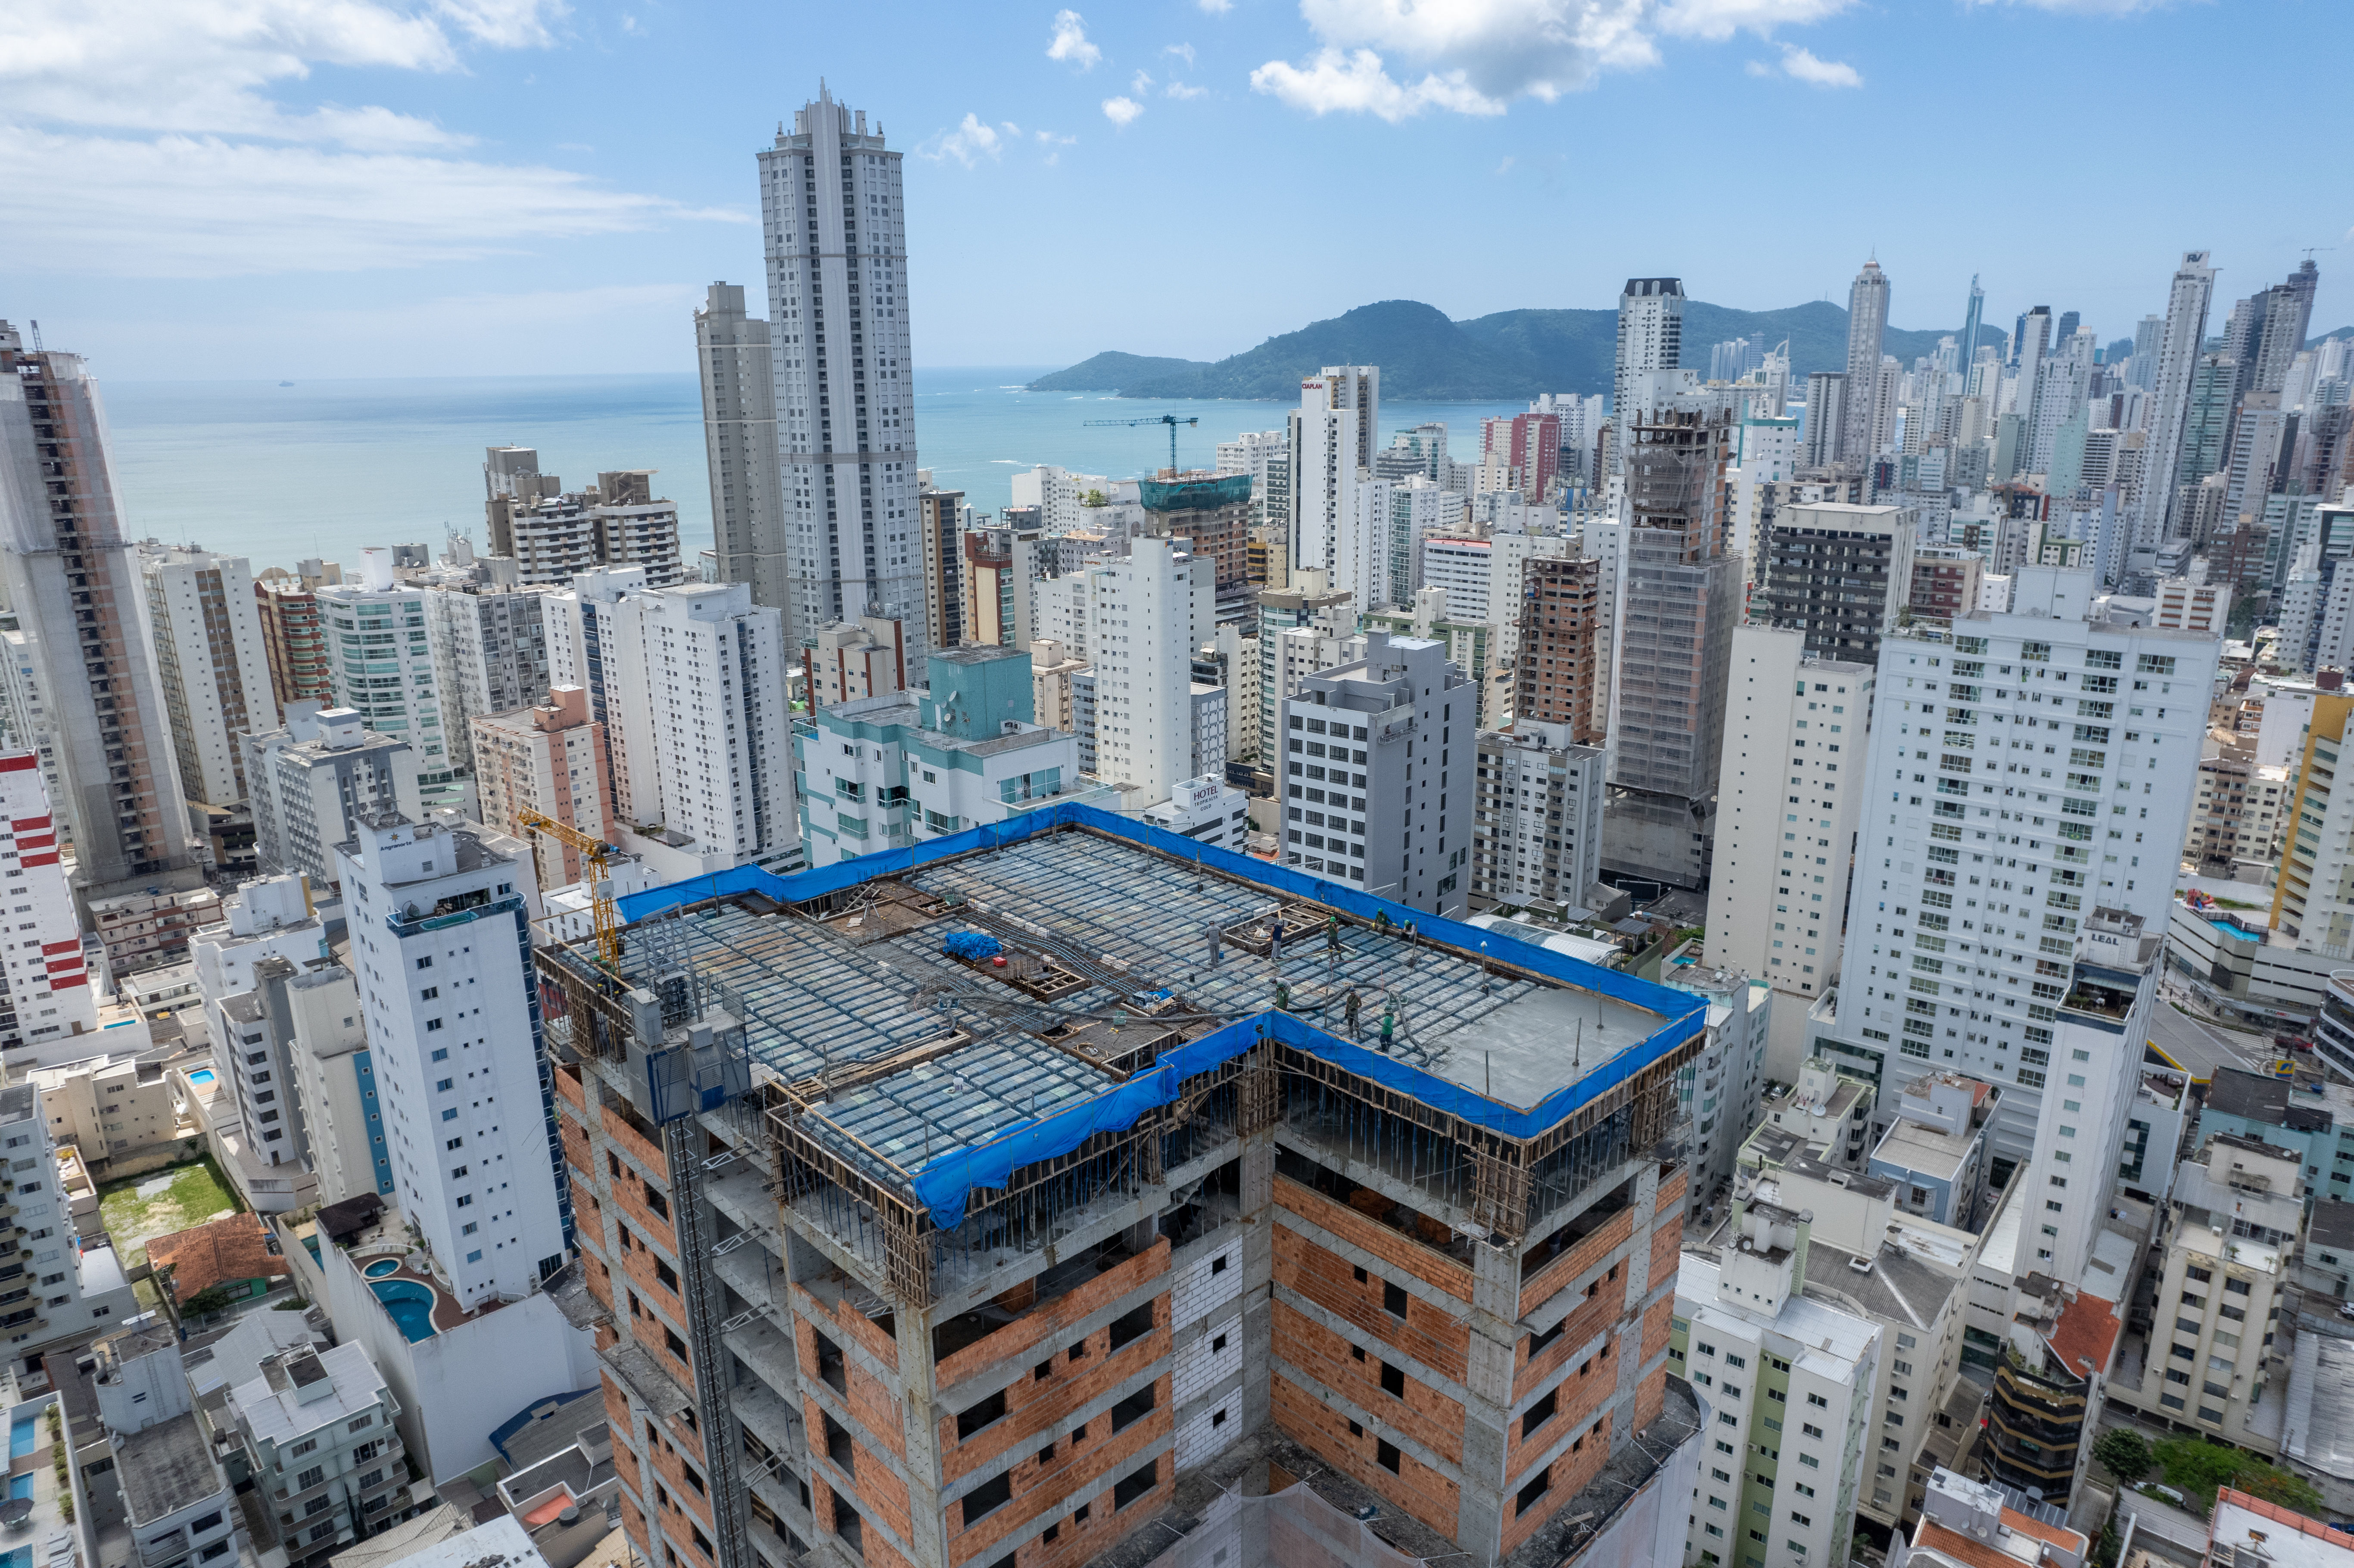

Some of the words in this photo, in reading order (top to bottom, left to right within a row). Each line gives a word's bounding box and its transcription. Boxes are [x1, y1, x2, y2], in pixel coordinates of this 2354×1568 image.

[1194, 786, 1218, 801] HOTEL
[1195, 795, 1218, 806] TROPIKALYA
[380, 841, 412, 851] Angranorte
[2092, 933, 2119, 946] LEAL
